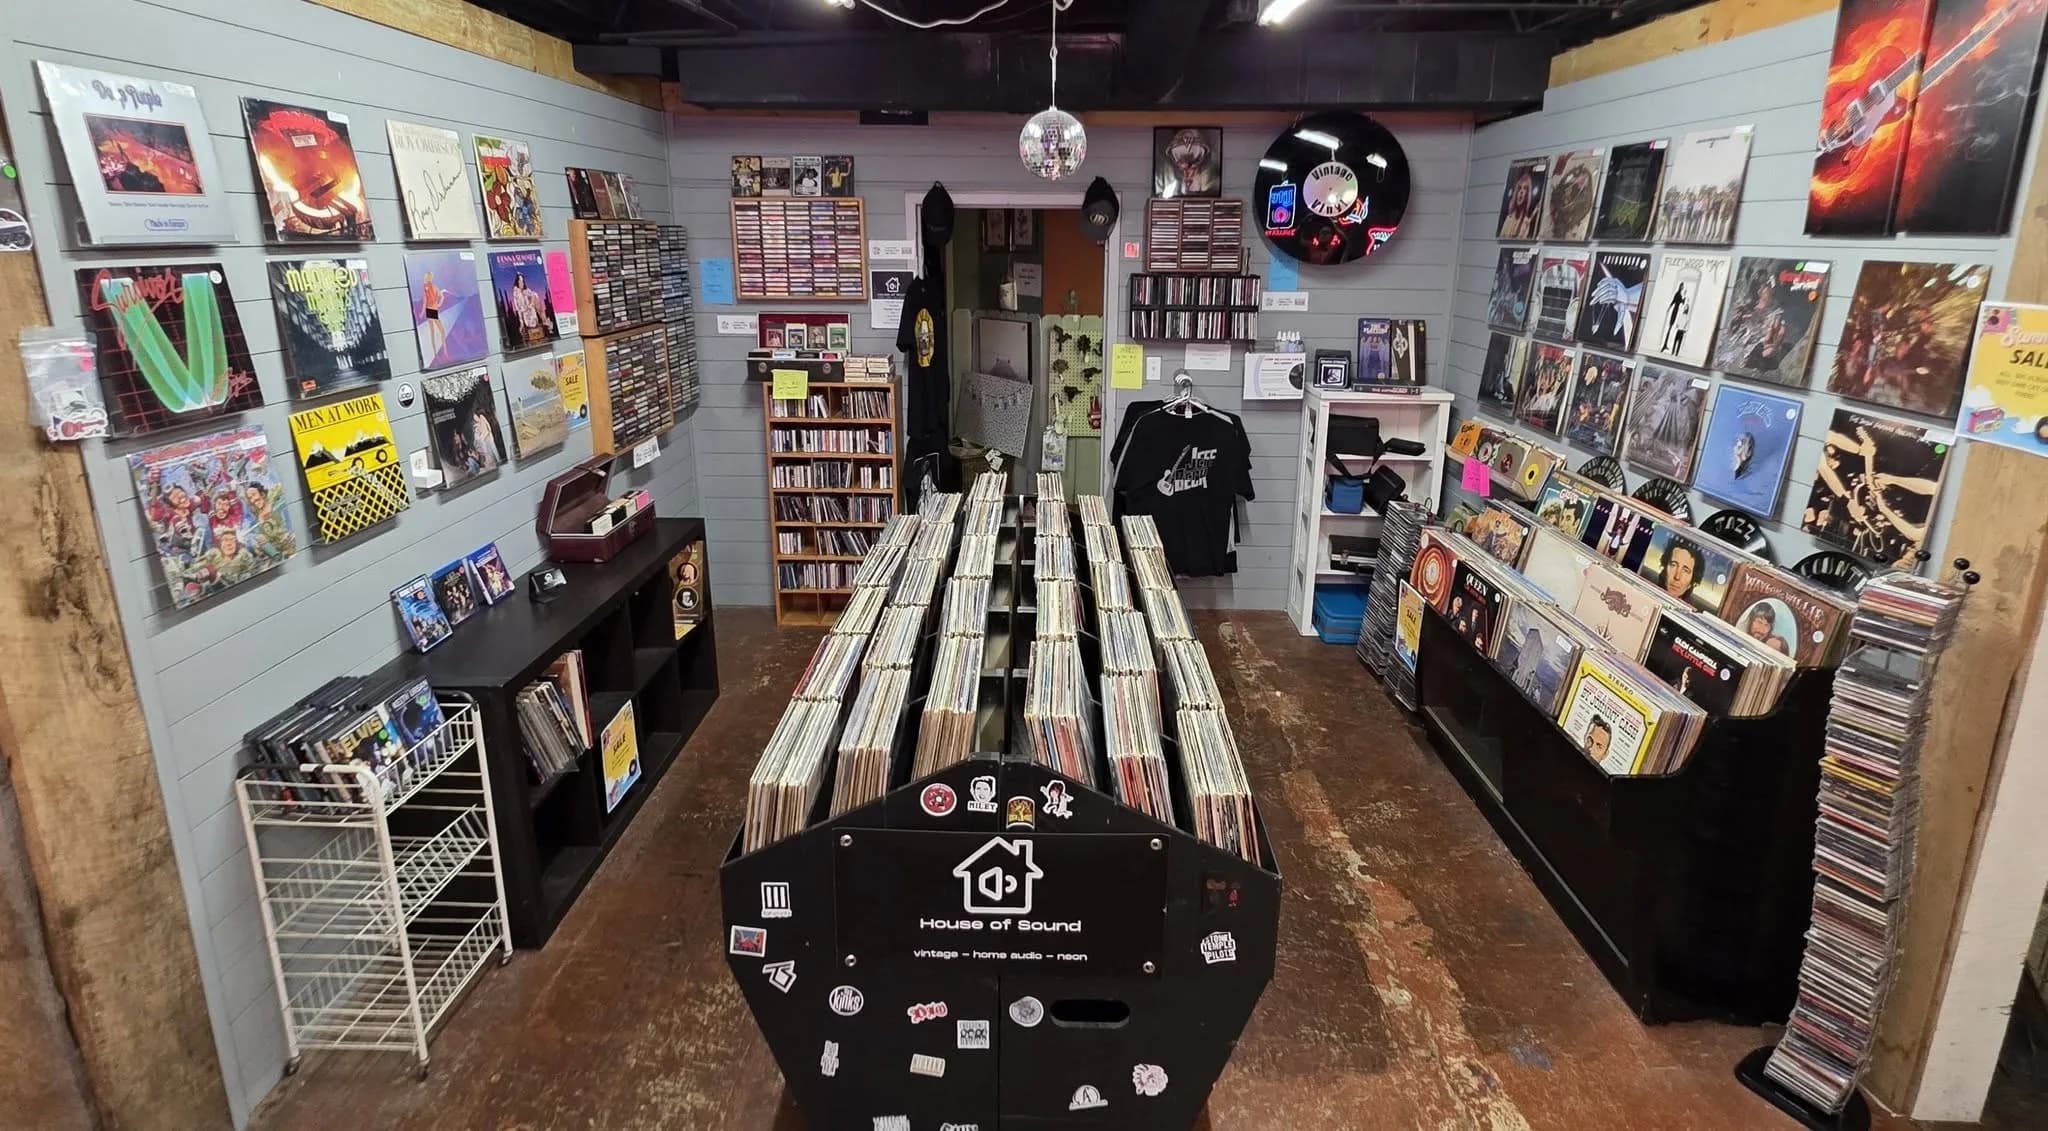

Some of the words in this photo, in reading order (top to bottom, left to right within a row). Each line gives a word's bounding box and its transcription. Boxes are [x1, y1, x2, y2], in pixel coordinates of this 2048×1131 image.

[92, 79, 128, 109] Dep
[1311, 165, 1354, 182] Vintage
[1311, 199, 1348, 215] Vinyl
[564, 374, 579, 387] SALE
[293, 412, 325, 432] MEN
[328, 404, 345, 425] AT
[344, 396, 381, 417] WORK
[1714, 516, 1756, 542] JAZZ
[1800, 556, 1868, 591] COUNT
[1466, 573, 1489, 597] QUEEN
[1406, 609, 1417, 624] SALE
[1607, 673, 1634, 696] STEREO
[339, 714, 385, 752] ELVIS
[612, 734, 627, 754] SALE
[969, 802, 996, 811] MILEY
[920, 918, 984, 930] House
[990, 918, 1012, 930] of
[1017, 920, 1082, 932] Sound
[1201, 941, 1233, 951] TEMPLE
[1207, 949, 1233, 960] PILOTS
[913, 949, 959, 960] vintage
[973, 950, 1008, 959] home
[1010, 951, 1043, 960] audio
[1057, 953, 1088, 962] neon
[834, 989, 860, 1012] kinks
